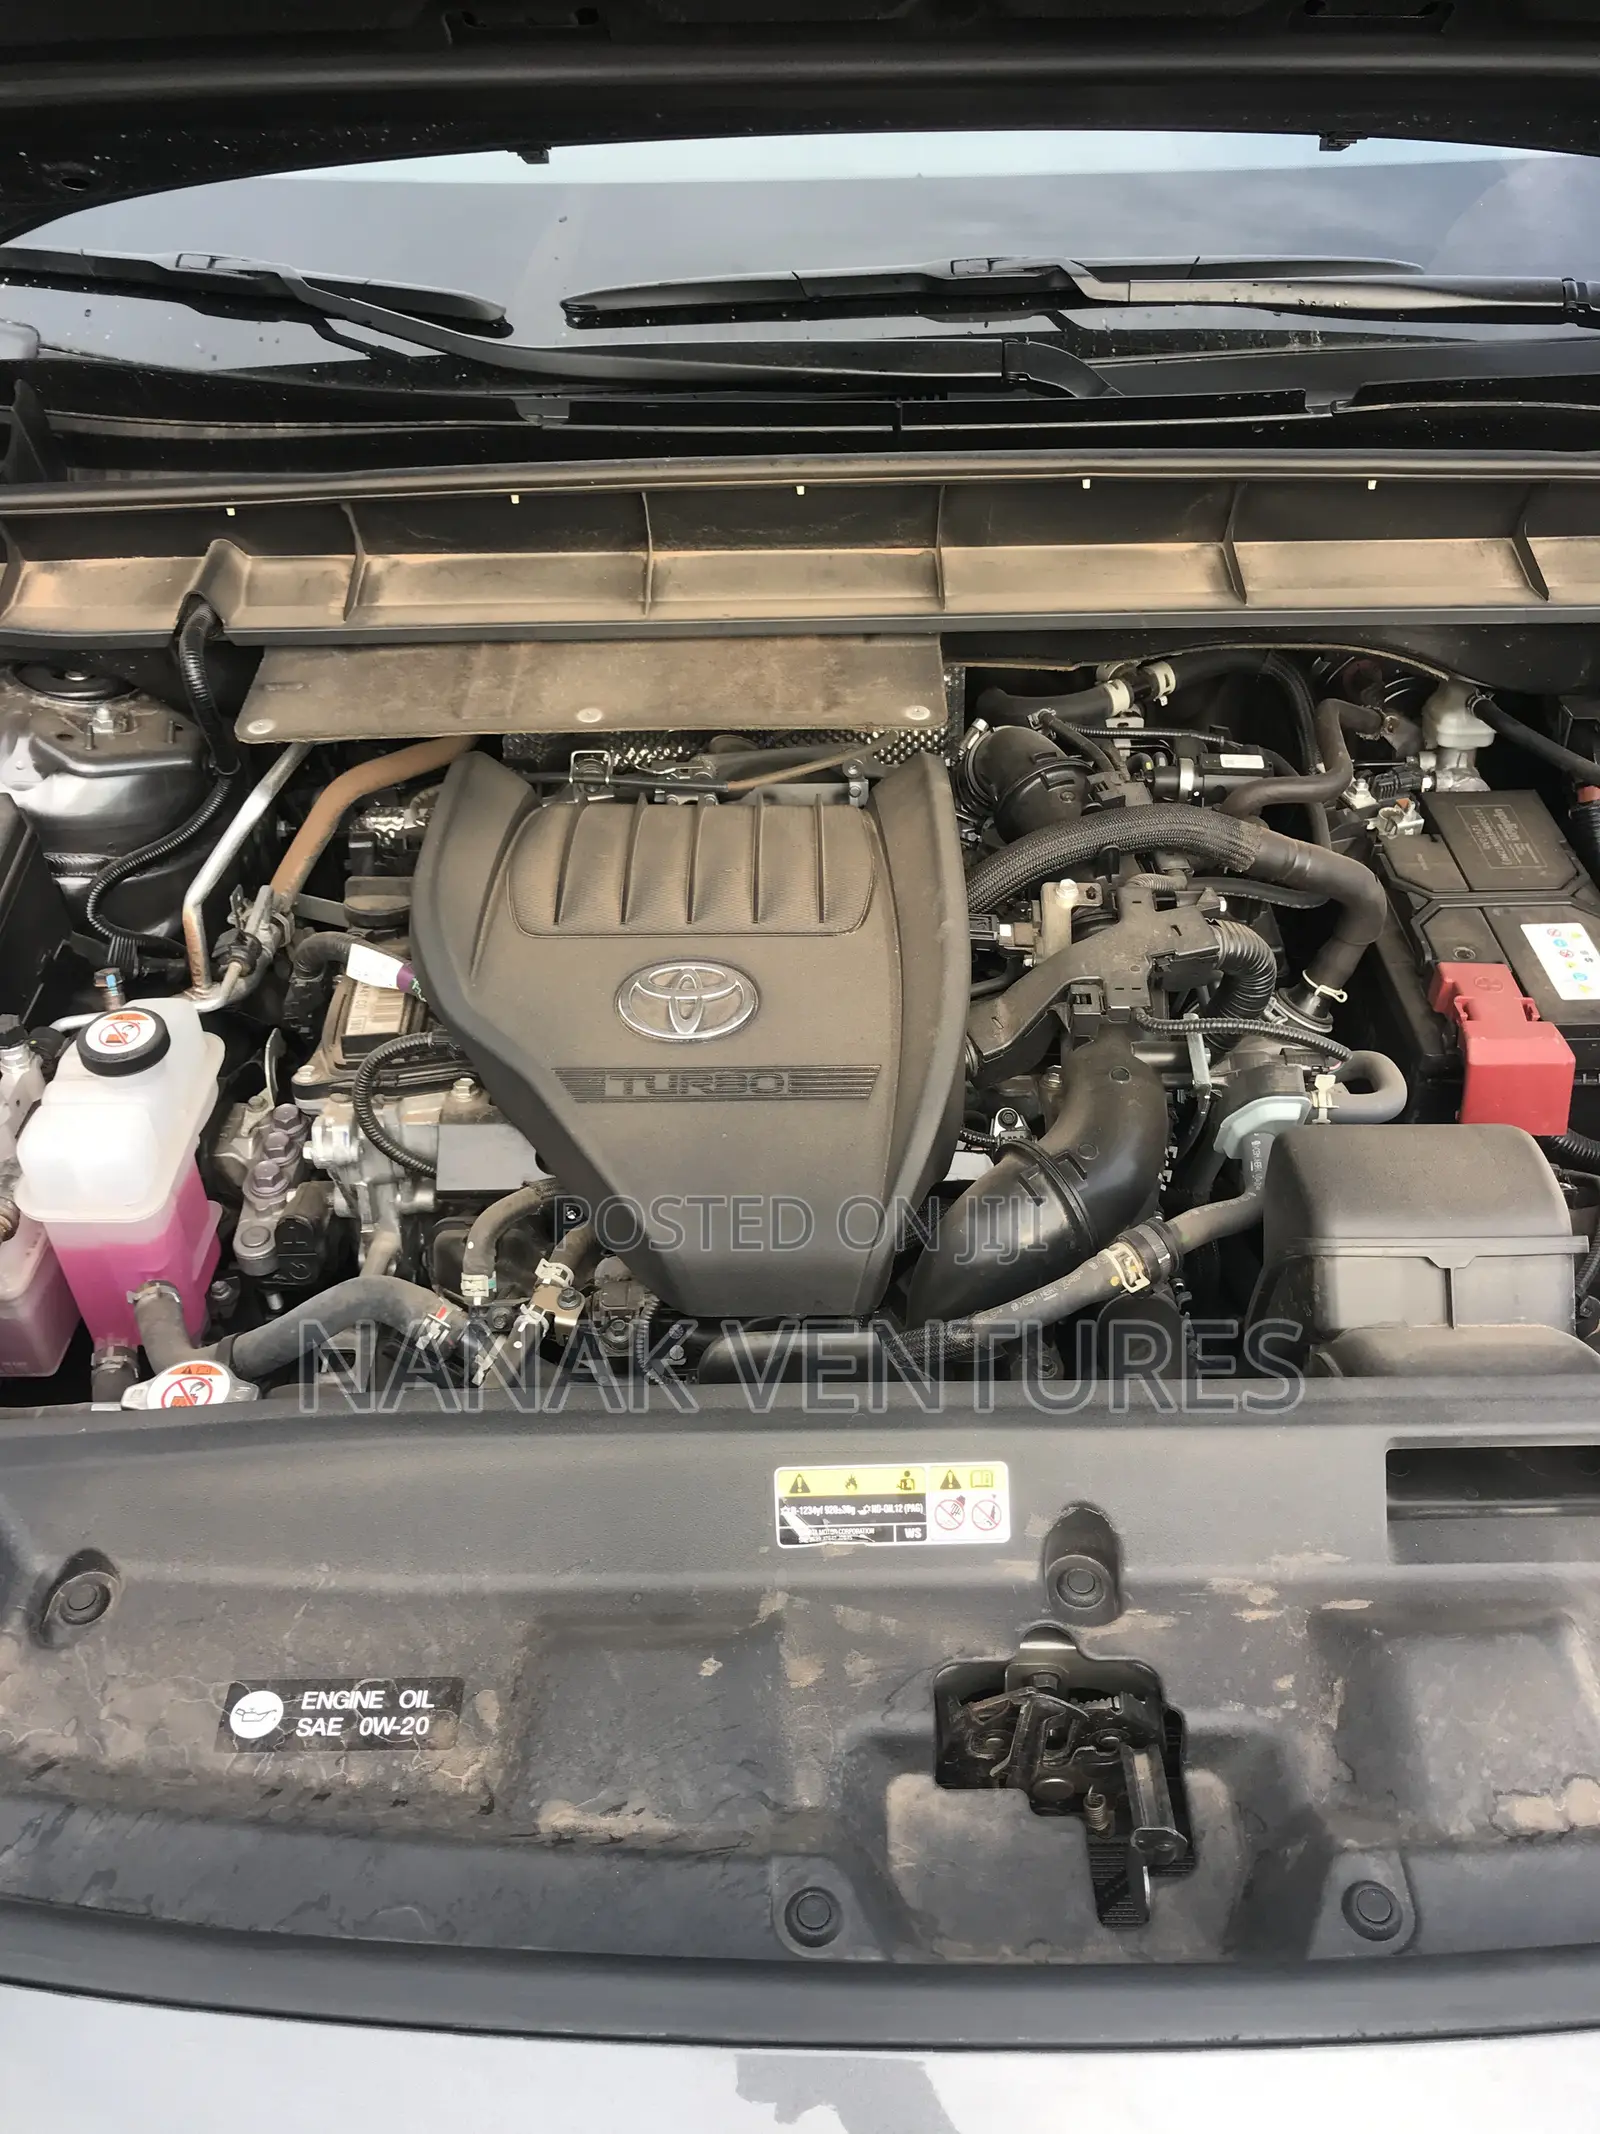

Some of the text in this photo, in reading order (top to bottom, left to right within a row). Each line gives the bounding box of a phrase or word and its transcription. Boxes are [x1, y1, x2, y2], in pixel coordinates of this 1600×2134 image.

[608, 1072, 785, 1095] TURBO
[904, 1527, 922, 1539] WS
[301, 1690, 435, 1710] ENGINE OIL
[296, 1716, 431, 1737] SAE 0W-20
